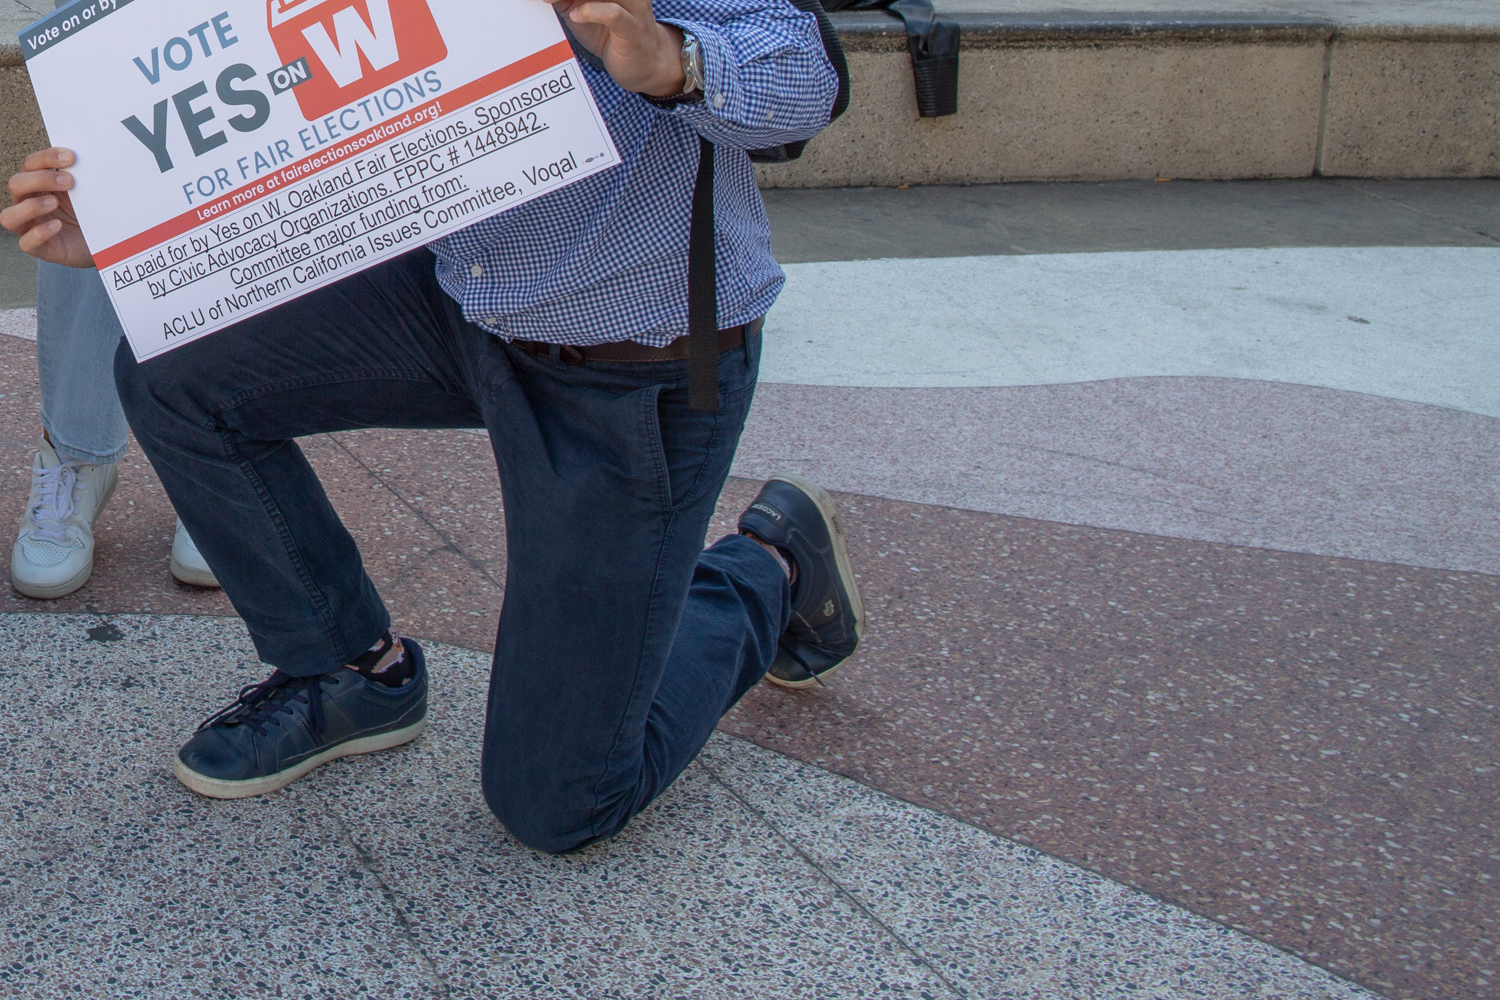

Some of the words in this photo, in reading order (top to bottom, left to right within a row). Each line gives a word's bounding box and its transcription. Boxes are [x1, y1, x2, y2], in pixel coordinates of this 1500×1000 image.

[26, 25, 60, 50] Vote
[61, 14, 81, 32] on
[81, 3, 96, 20] or
[131, 9, 239, 86] VOTE
[120, 62, 271, 174] YES
[272, 59, 308, 89] ON
[181, 166, 234, 205] FOR
[235, 138, 295, 180] FAIR
[296, 68, 442, 152] ELECTIONS
[195, 198, 232, 221] Learn
[231, 183, 265, 205] more
[265, 174, 281, 190] at
[280, 99, 443, 183] fairelectionsoakland.org!
[112, 264, 134, 289] Ad
[133, 249, 169, 282] paid
[166, 242, 188, 263] for
[188, 233, 213, 257] by
[208, 221, 241, 243] Yes
[241, 211, 263, 230] on
[261, 197, 288, 224] W,
[287, 165, 354, 209] Oakland
[353, 152, 387, 180] Fair
[388, 119, 474, 168] Elections,
[473, 68, 575, 131] Sponsored
[145, 277, 170, 300] by
[167, 260, 206, 287] Civic
[206, 228, 282, 276] Advocacy
[279, 181, 395, 243] Organizations.
[392, 152, 445, 189] FPPC
[446, 144, 461, 167] #
[463, 110, 547, 158] 1448942.
[229, 241, 312, 286] Committee
[312, 220, 362, 255] major
[358, 194, 423, 235] funding
[420, 173, 468, 204] from:
[162, 307, 206, 340] ACLU
[208, 298, 224, 320] of
[223, 275, 292, 314] Northern
[292, 243, 367, 284] California
[366, 220, 422, 254] Issues
[422, 180, 523, 229] Committee,
[521, 150, 578, 186] Voqal
